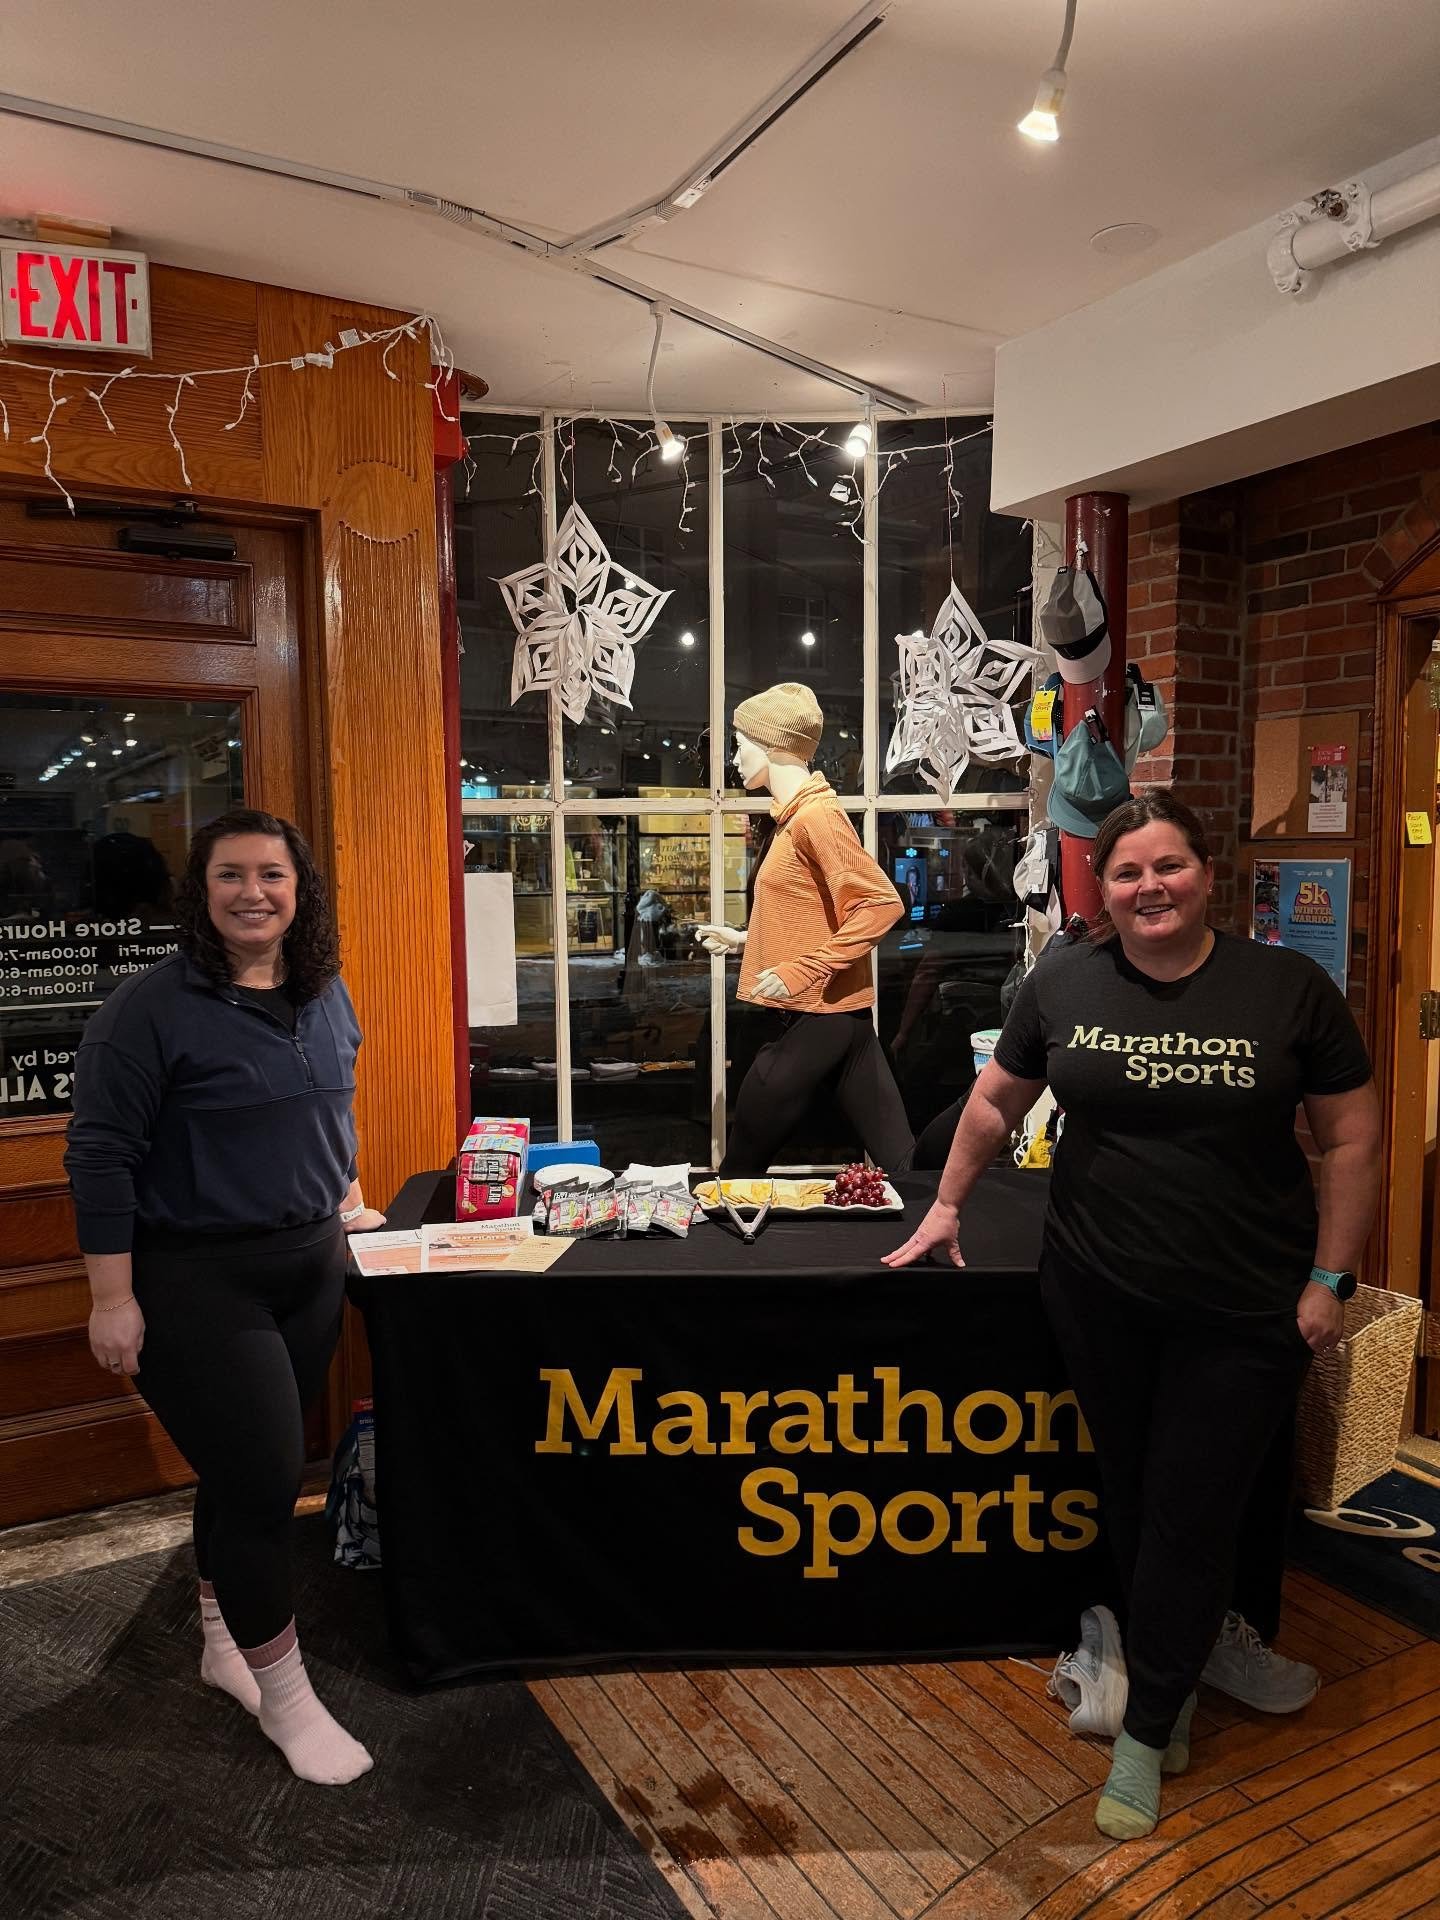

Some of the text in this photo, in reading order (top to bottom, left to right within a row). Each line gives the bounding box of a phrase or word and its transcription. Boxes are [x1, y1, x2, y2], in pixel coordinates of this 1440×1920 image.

[17, 252, 136, 344] EXIT
[1291, 914, 1335, 924] WARRIOR
[1294, 905, 1332, 915] WINTER
[1067, 1025, 1256, 1058] Marathon
[1125, 1055, 1256, 1089] Sports
[535, 1366, 1095, 1456] Marathon
[737, 1466, 1099, 1578] Sports
